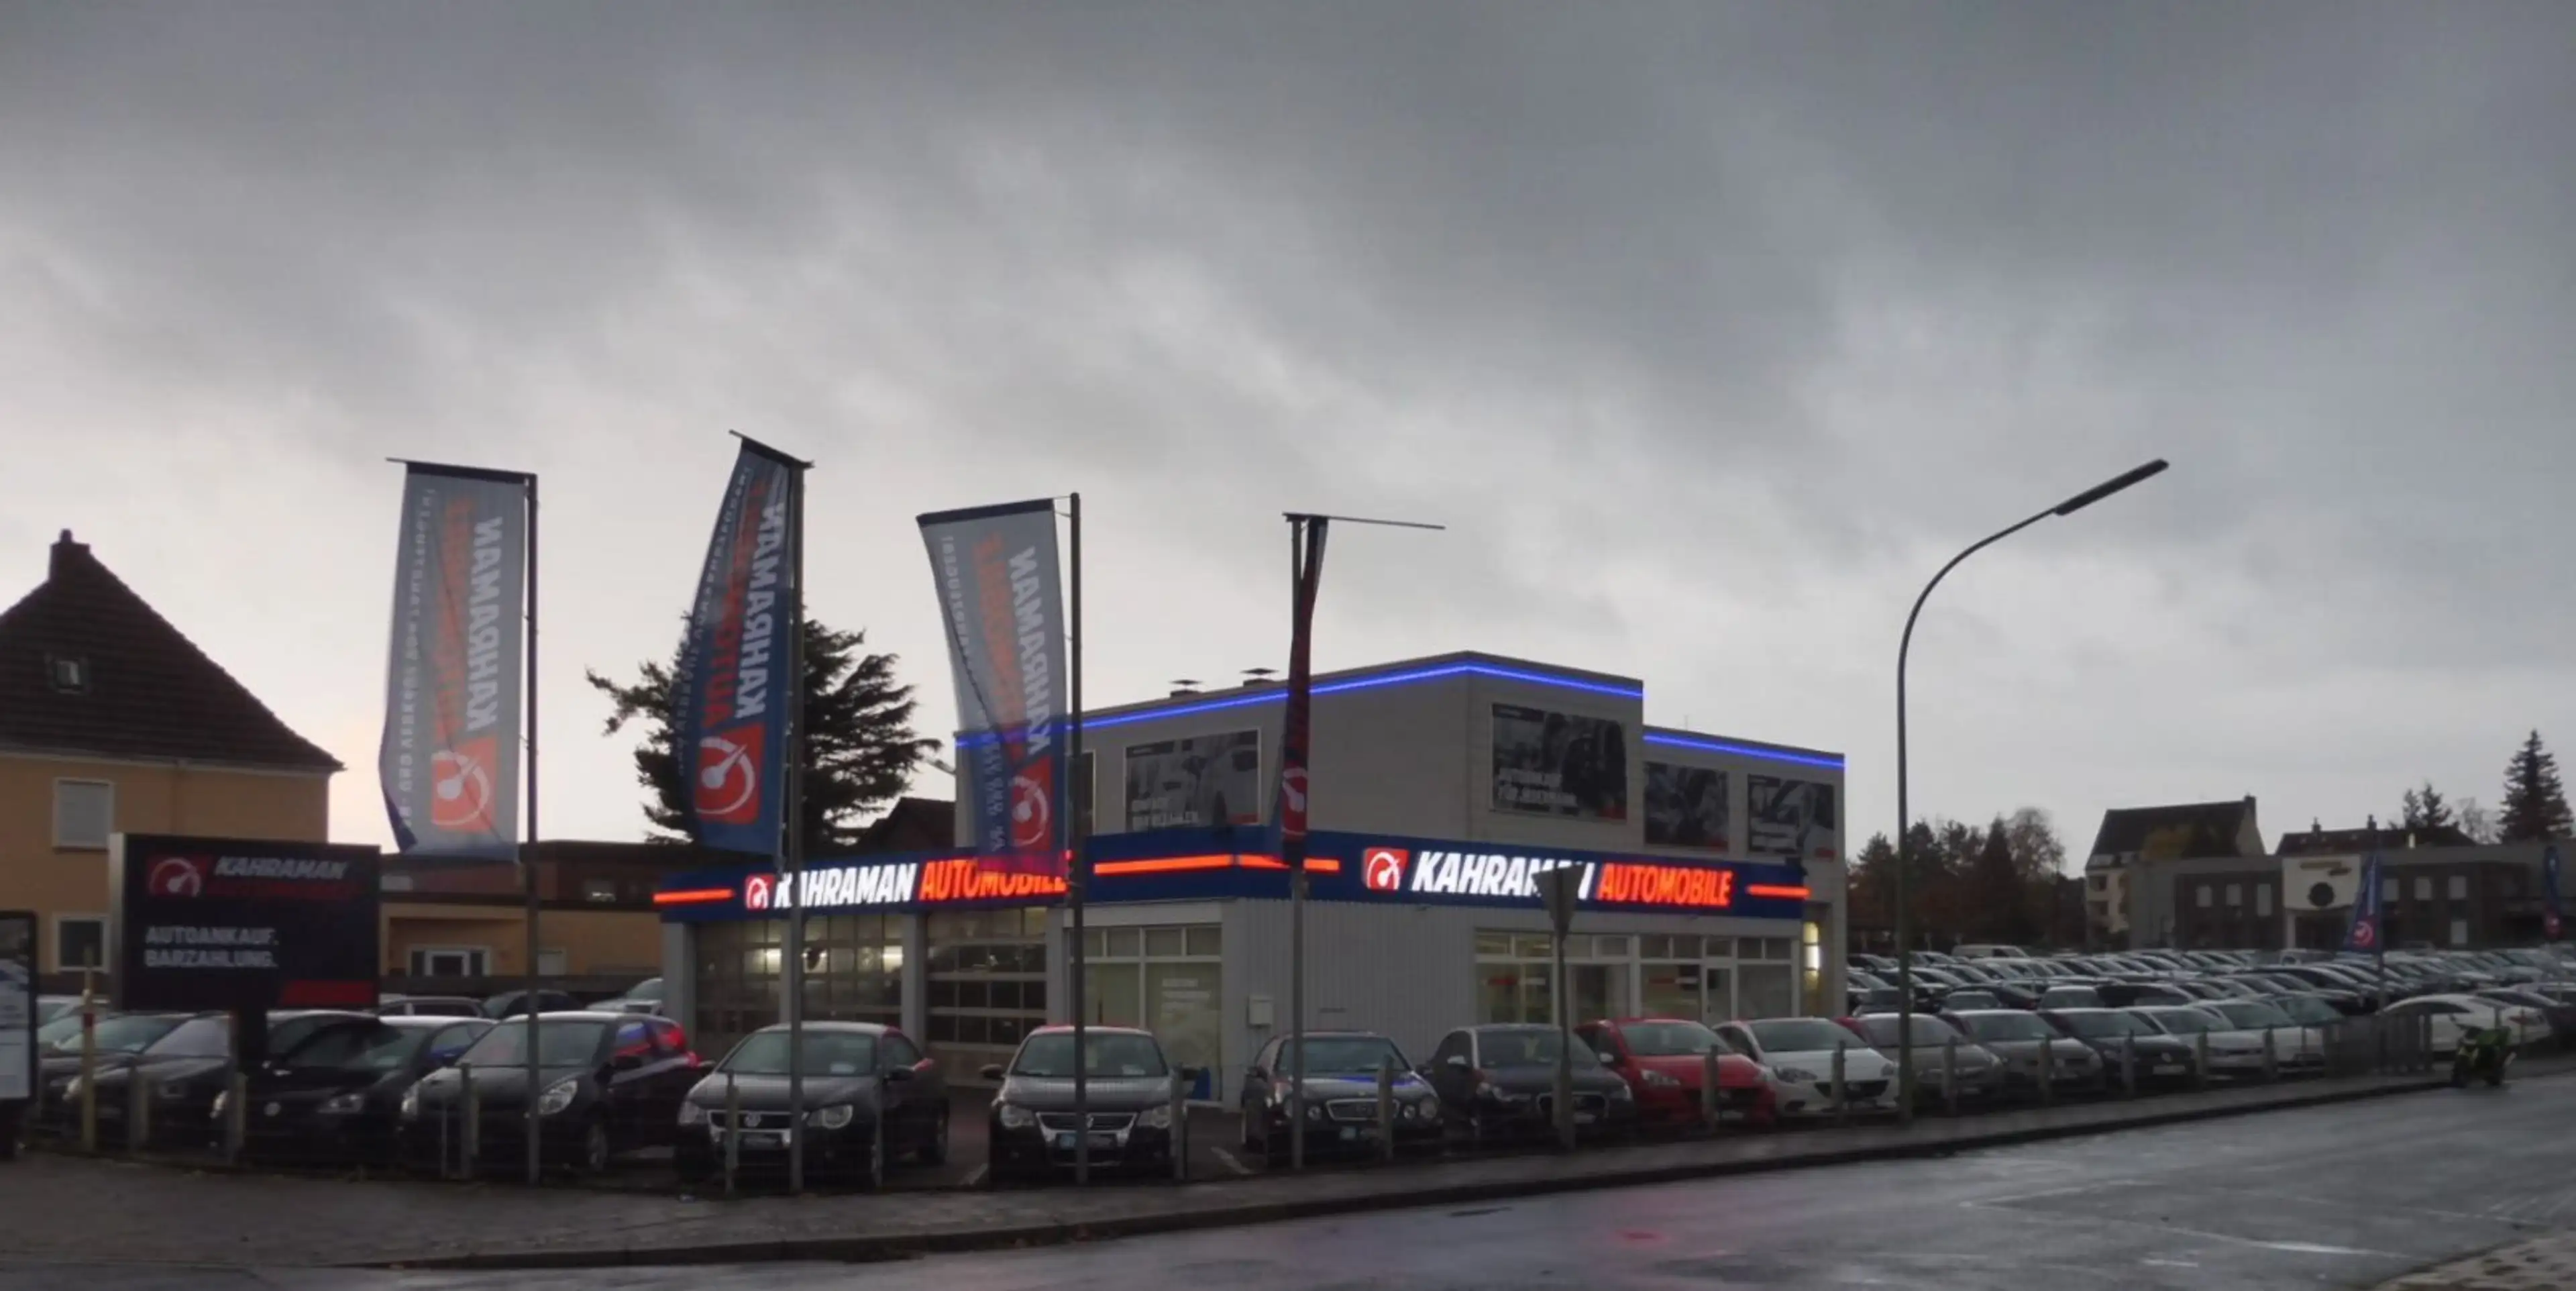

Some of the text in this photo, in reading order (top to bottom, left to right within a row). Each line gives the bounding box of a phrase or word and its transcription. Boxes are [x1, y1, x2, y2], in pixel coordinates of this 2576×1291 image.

[213, 856, 347, 880] KAHRAMAN
[1411, 850, 1733, 907] KAHRAMN AUTOMOBILE
[144, 925, 280, 945] AUTOANKAUF.
[144, 949, 279, 968] BARZAHLUNG.
